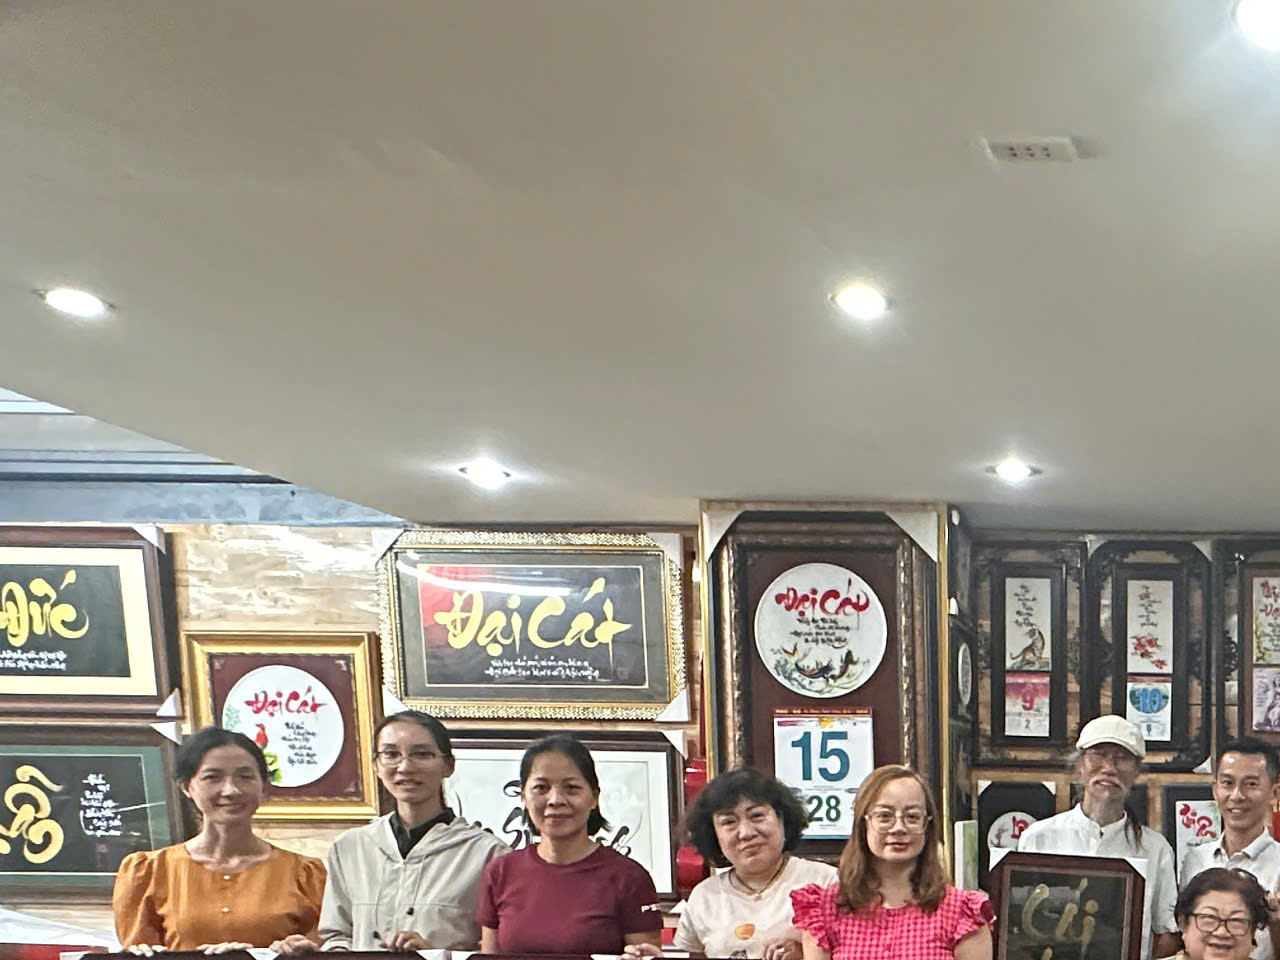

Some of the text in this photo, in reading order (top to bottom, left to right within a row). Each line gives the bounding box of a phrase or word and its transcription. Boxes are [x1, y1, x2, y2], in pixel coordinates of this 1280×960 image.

[433, 577, 632, 660] Đại Cát
[791, 731, 850, 782] 15
[807, 795, 841, 822] 28
